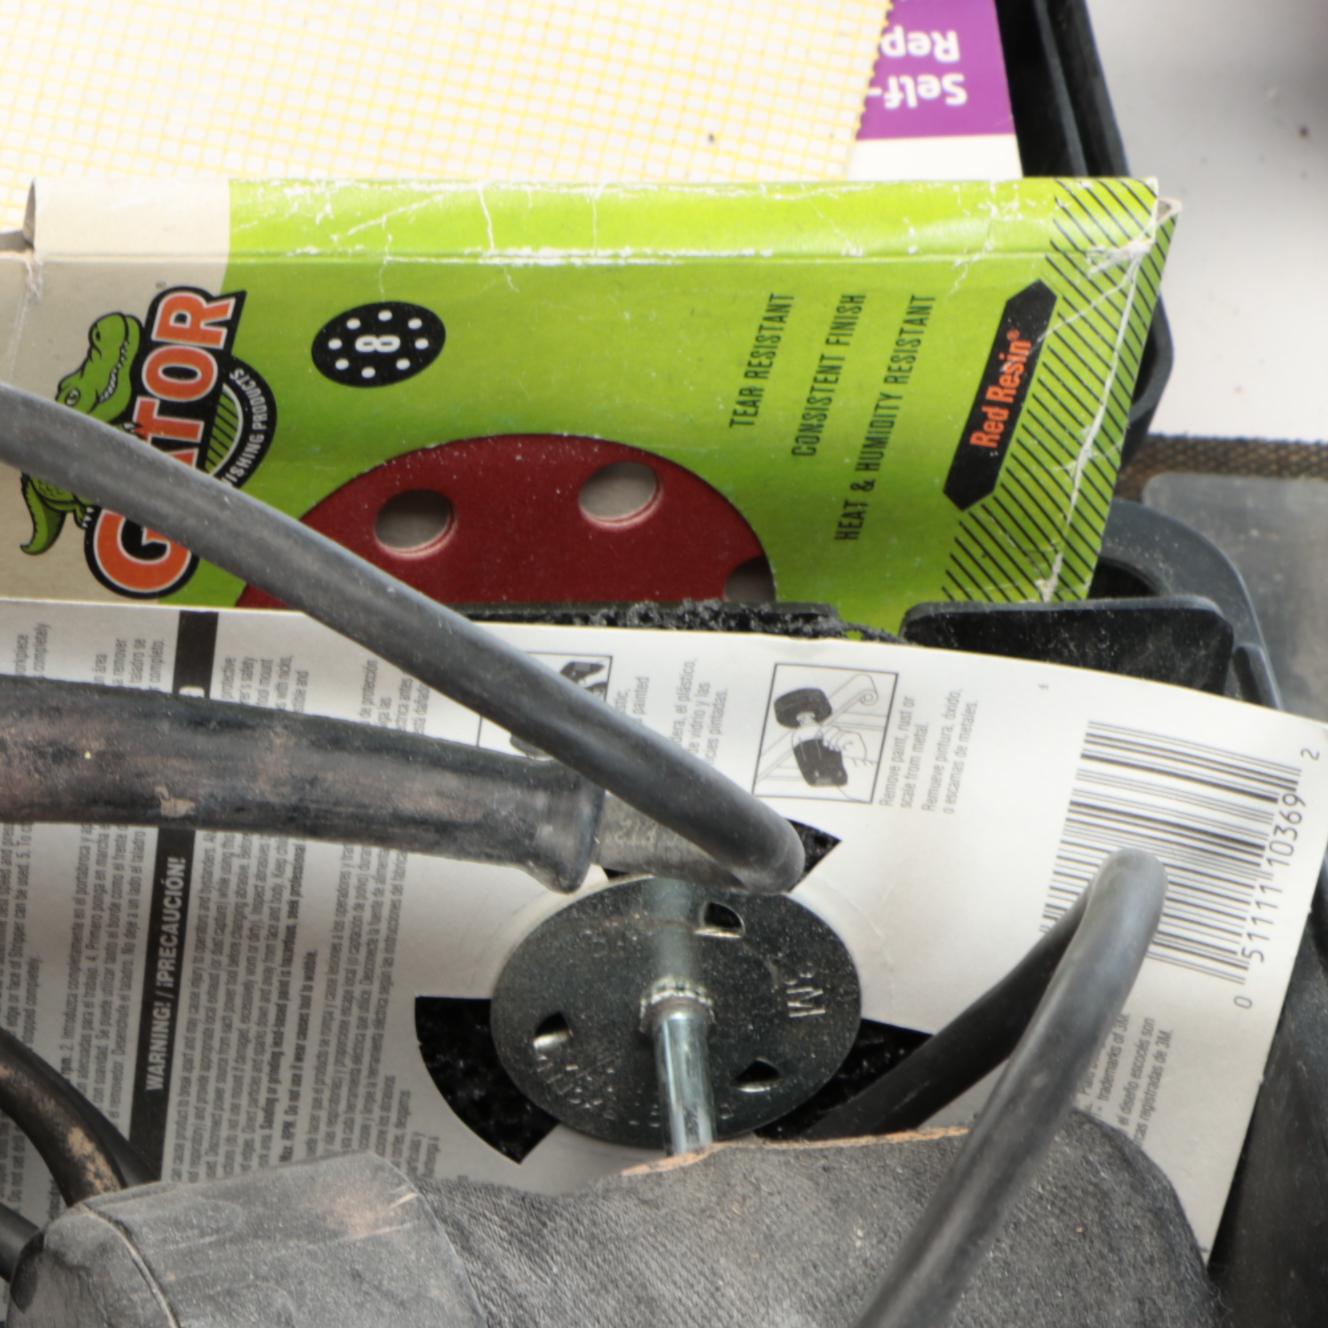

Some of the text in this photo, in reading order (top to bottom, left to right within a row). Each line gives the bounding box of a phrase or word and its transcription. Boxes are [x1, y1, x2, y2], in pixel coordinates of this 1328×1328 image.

[229, 367, 269, 431] PRODUCTS
[355, 334, 401, 353] 8
[729, 293, 794, 429] TEAR RESISTANT
[791, 293, 866, 457] CONSISTENT FINISH
[92, 289, 237, 596] GTOR
[834, 294, 936, 541] HEAT & HUMIDITY RESISTANT
[969, 404, 1010, 448] Red
[1233, 746, 1320, 1009] 0 51111 10369 2
[145, 1000, 171, 1091] WARNING!
